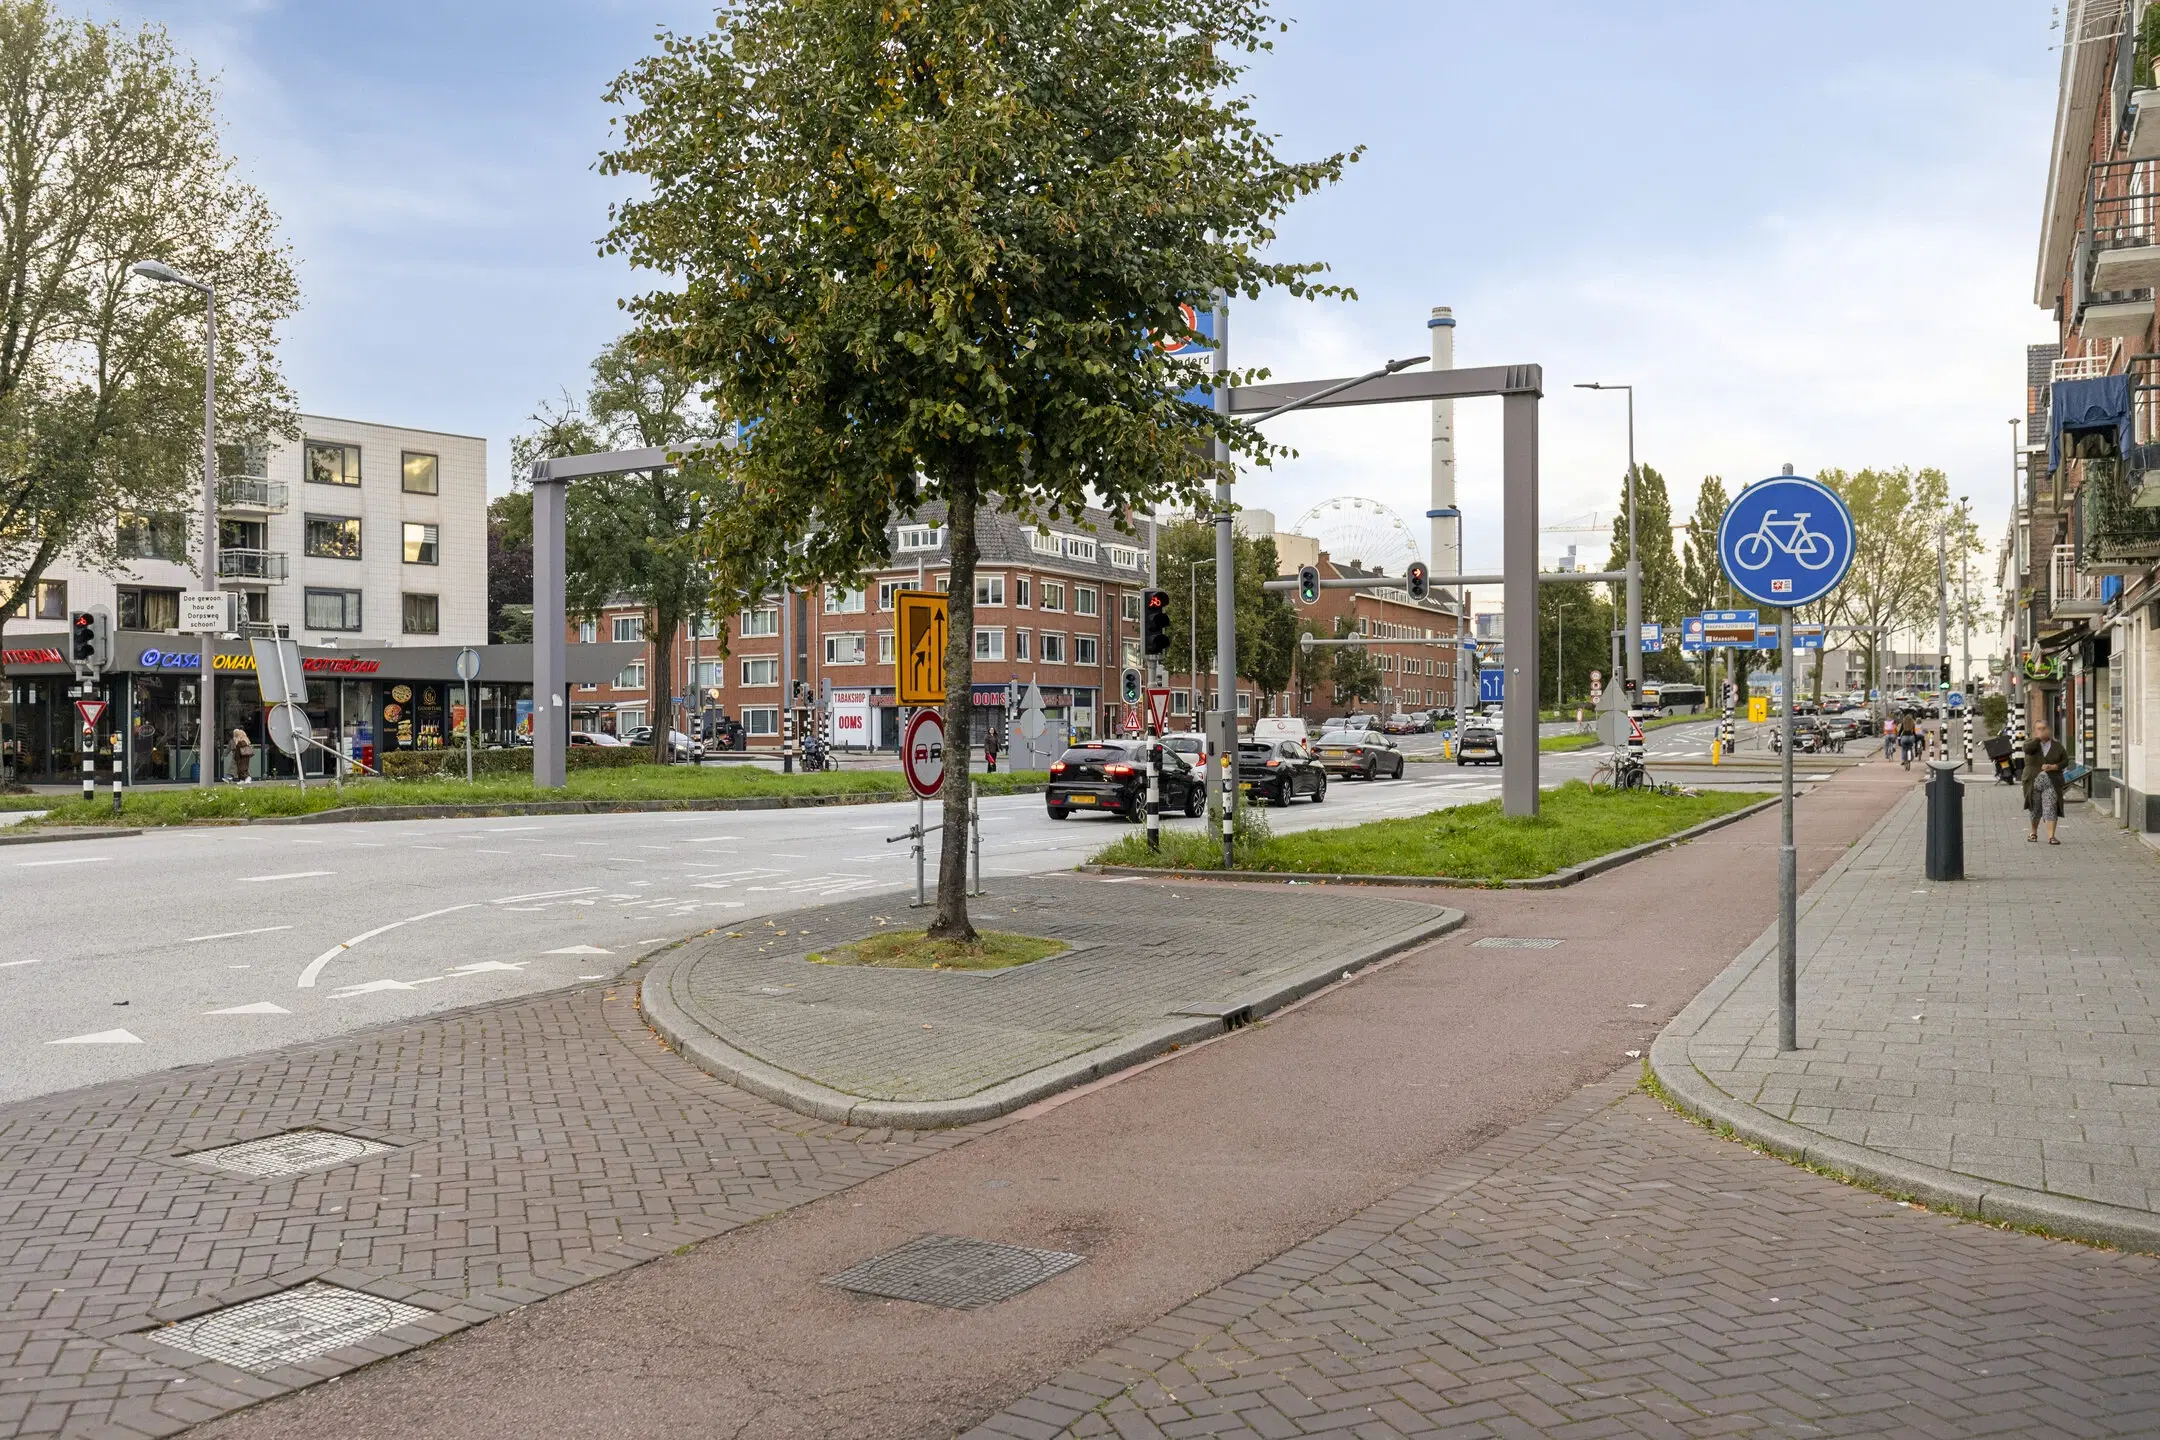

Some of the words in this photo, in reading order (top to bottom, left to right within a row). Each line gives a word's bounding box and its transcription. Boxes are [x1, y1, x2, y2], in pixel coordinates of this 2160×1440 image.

[162, 652, 200, 668] CASA
[212, 654, 256, 669] OMAN
[303, 658, 380, 672] ROTTERDAM
[834, 692, 866, 703] TABAKSHOP
[973, 692, 1006, 706] OOMS
[838, 715, 863, 729] OOMS
[256, 1313, 382, 1357] DRAINAGE
